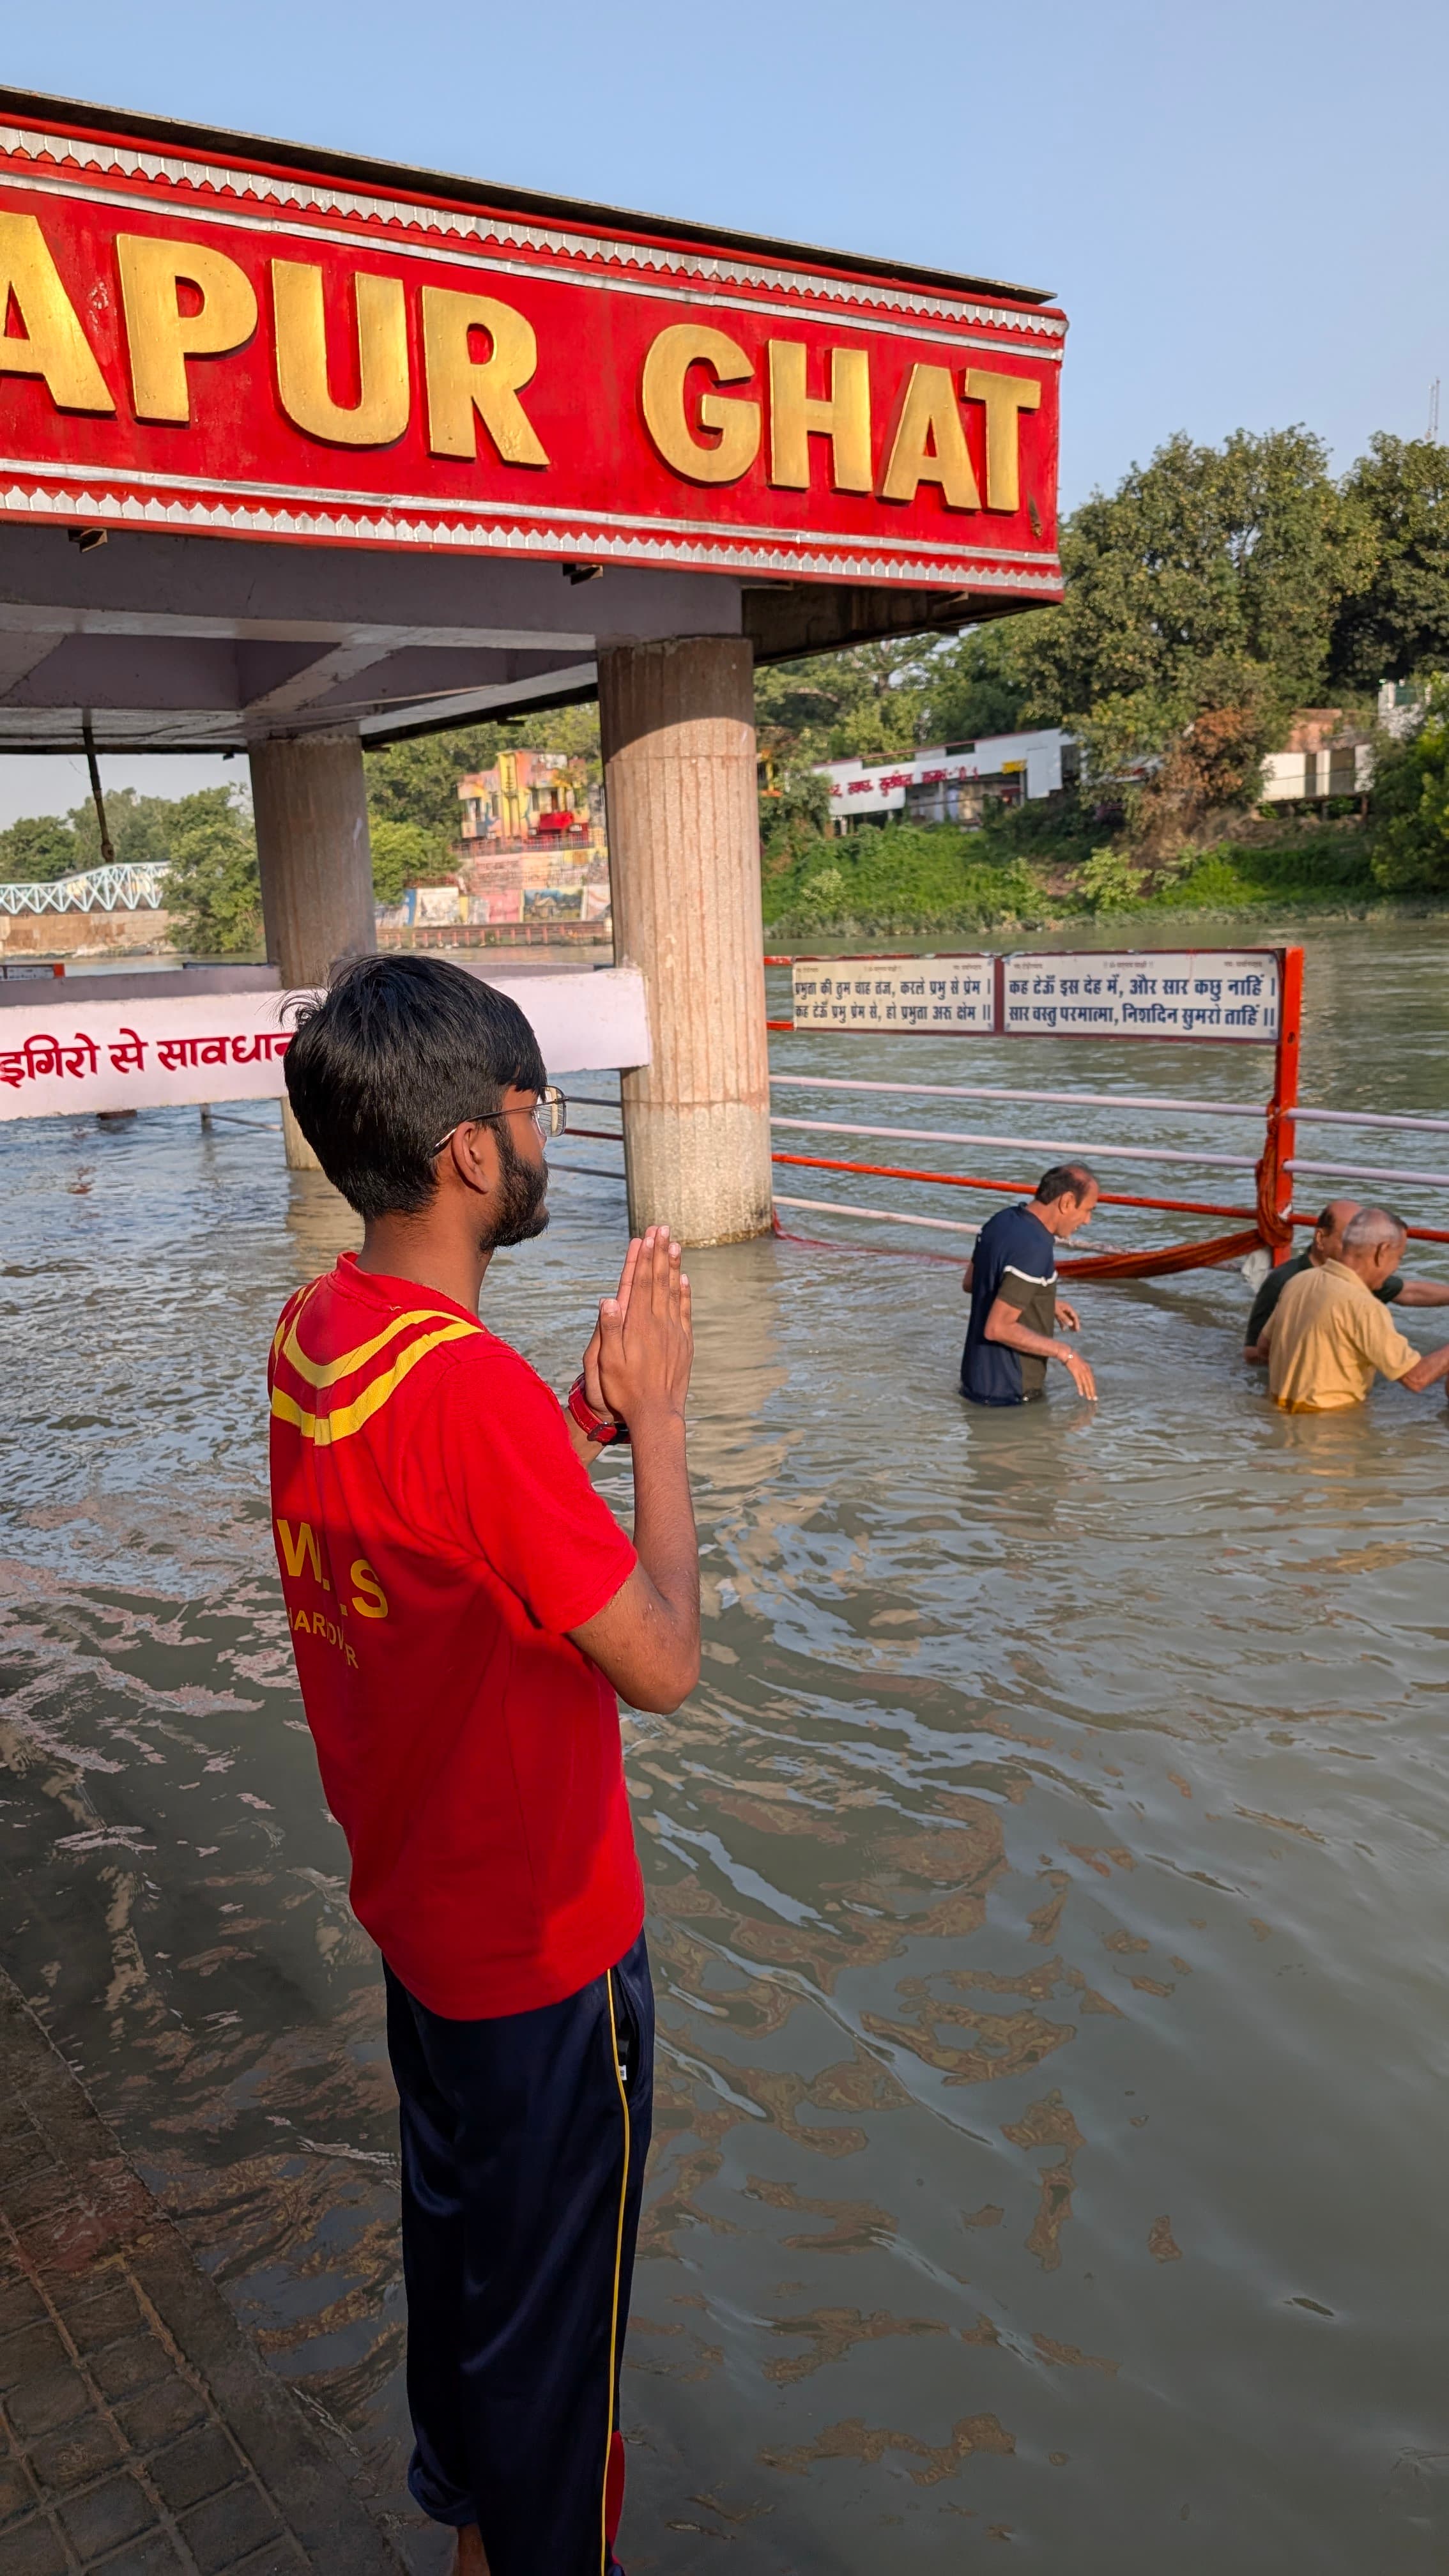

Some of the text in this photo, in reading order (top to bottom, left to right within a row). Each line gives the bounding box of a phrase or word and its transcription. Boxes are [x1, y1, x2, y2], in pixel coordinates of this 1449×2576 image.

[0, 210, 1041, 513] APUR GHAT
[820, 978, 832, 995] की
[900, 976, 925, 995] करले
[930, 981, 946, 1000] प्रभु
[950, 976, 960, 995] से
[963, 976, 981, 995] प्रेम
[1009, 980, 1029, 995] कह
[1059, 979, 1080, 997] इस
[1084, 975, 1102, 995] देह
[1107, 974, 1124, 998] में,
[1130, 974, 1158, 995] और
[1162, 979, 1190, 995] सार
[1194, 979, 1223, 1002] कछु
[1227, 974, 1265, 997] नाहिं
[831, 1006, 847, 1023] प्रभु
[850, 1002, 865, 1019] प्रेम
[901, 1006, 928, 1025] प्रभुता
[1009, 1007, 1030, 1022] सार
[1032, 1007, 1058, 1027] वस्तु
[1059, 1007, 1119, 1026] परमात्मा,
[1123, 1003, 1179, 1023] निशदिन
[1182, 1004, 1222, 1031] सुमरो
[1224, 1004, 1261, 1026] ताहिं
[107, 1027, 150, 1074] से
